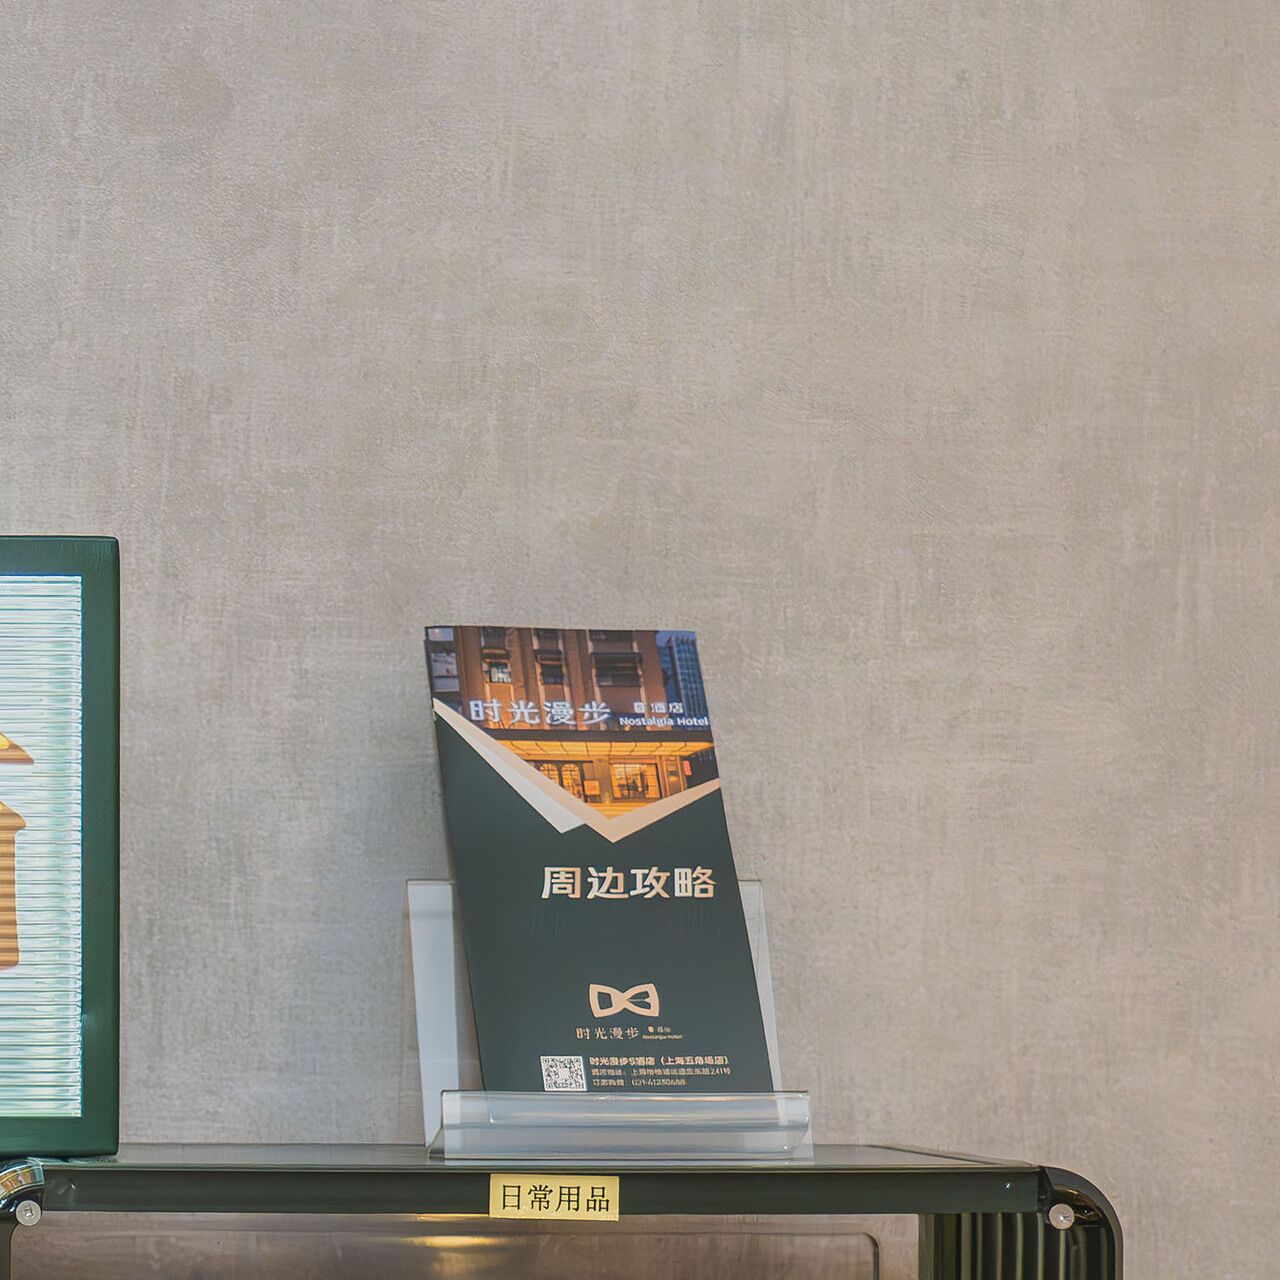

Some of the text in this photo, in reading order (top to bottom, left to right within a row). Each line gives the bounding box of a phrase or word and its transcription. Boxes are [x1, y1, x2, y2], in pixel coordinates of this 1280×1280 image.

[469, 700, 611, 725] 时光漫步
[619, 716, 709, 726] Nostalgia Hotel
[541, 866, 717, 899] 周边攻略
[576, 1027, 639, 1040] 时光漫步
[502, 1184, 610, 1213] 日常用品
